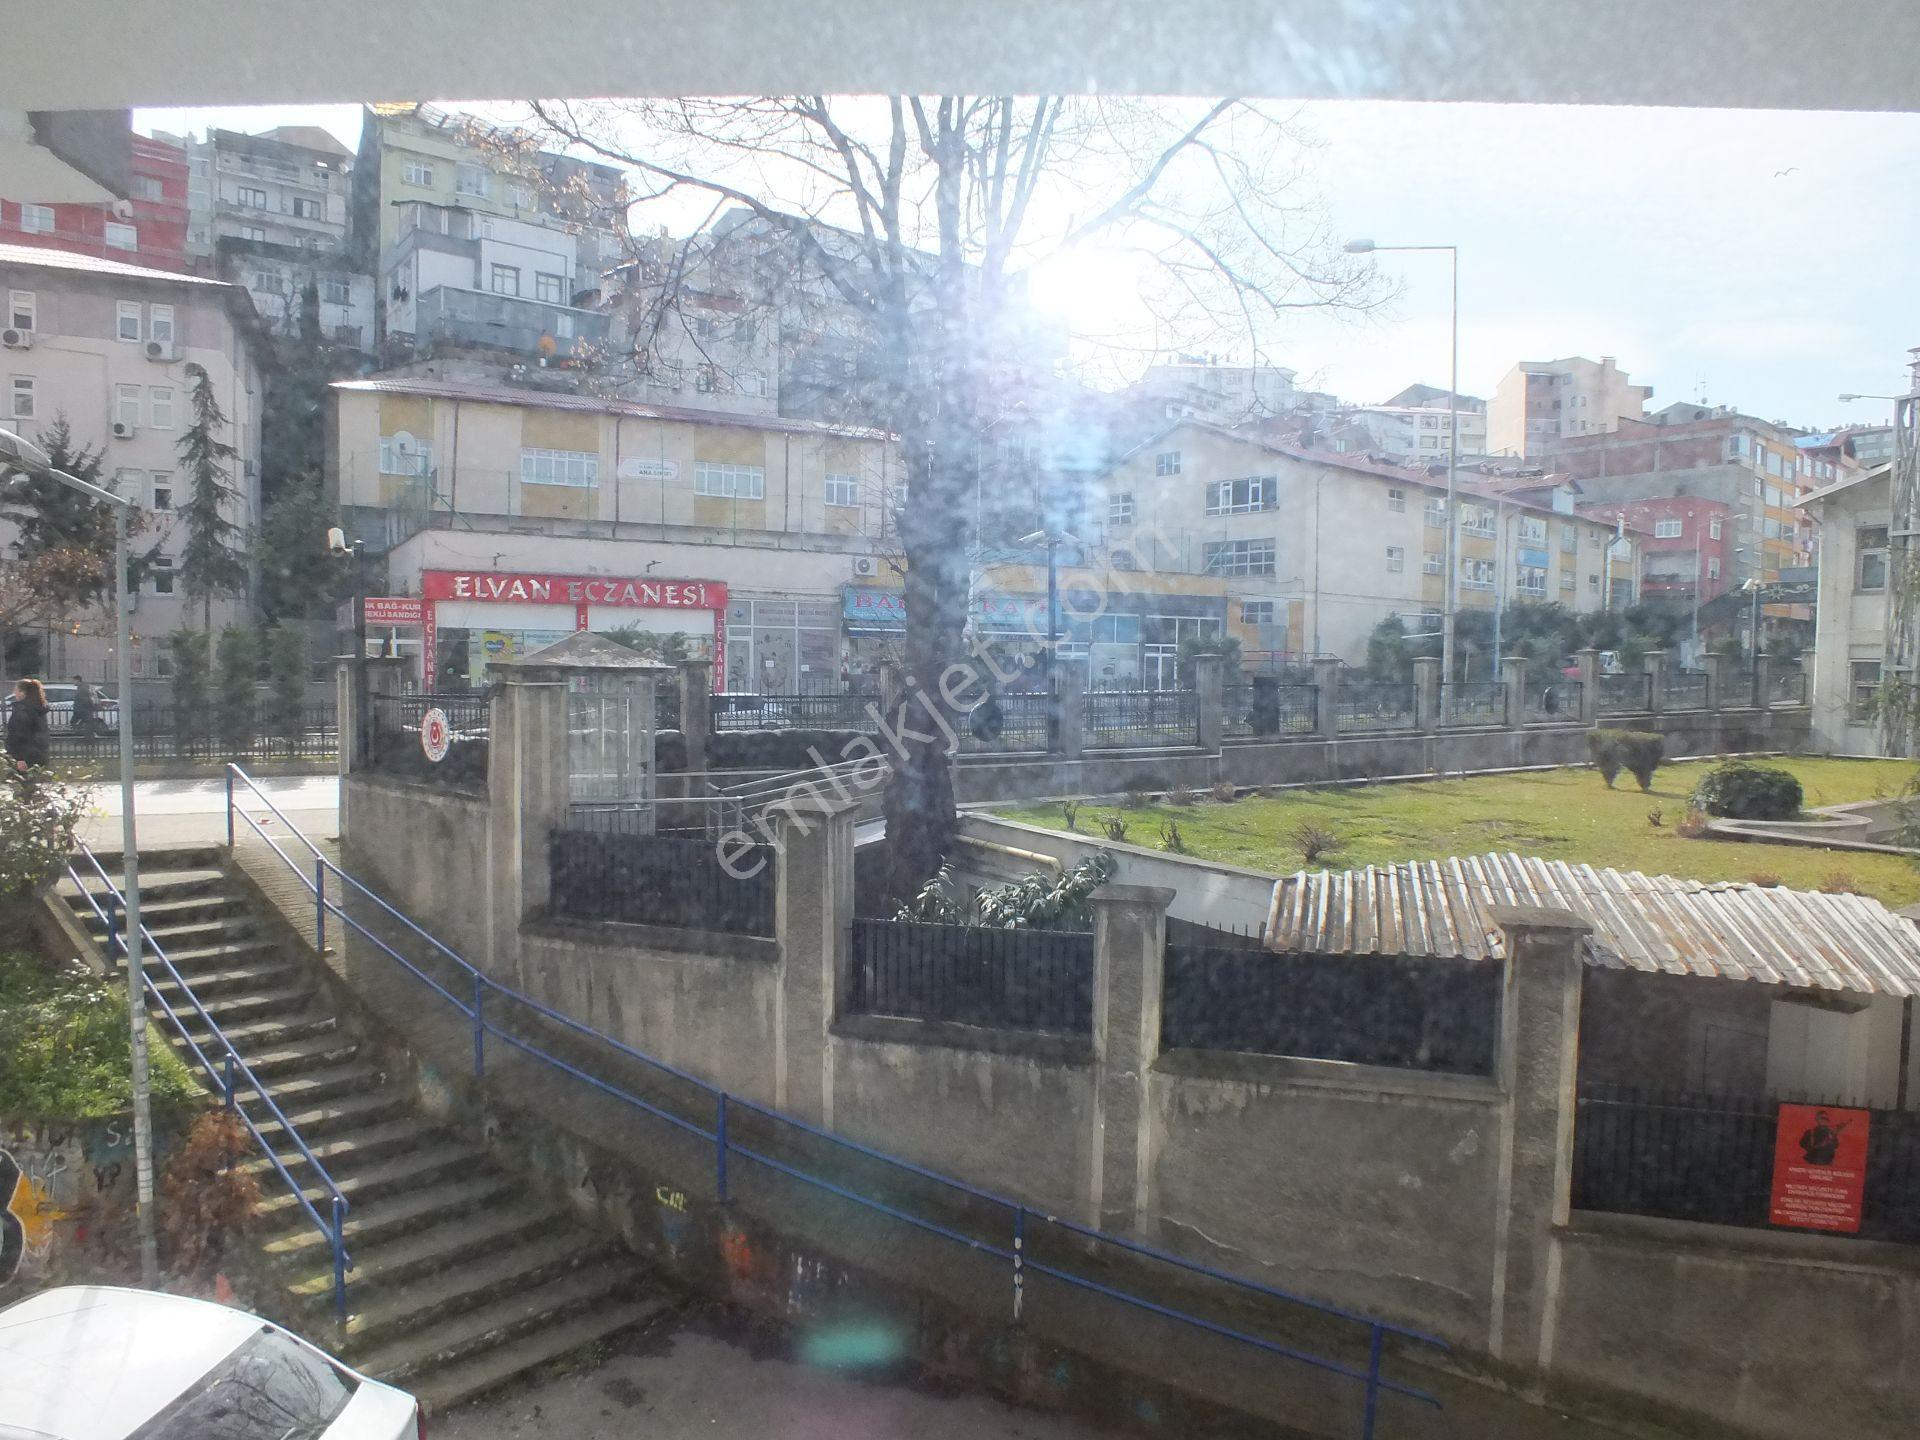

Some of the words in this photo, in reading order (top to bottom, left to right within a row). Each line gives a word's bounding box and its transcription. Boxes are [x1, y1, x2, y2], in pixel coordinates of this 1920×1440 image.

[453, 575, 551, 600] ELVAN
[567, 581, 707, 606] ECZANESİ
[426, 610, 434, 685] ECZANE
